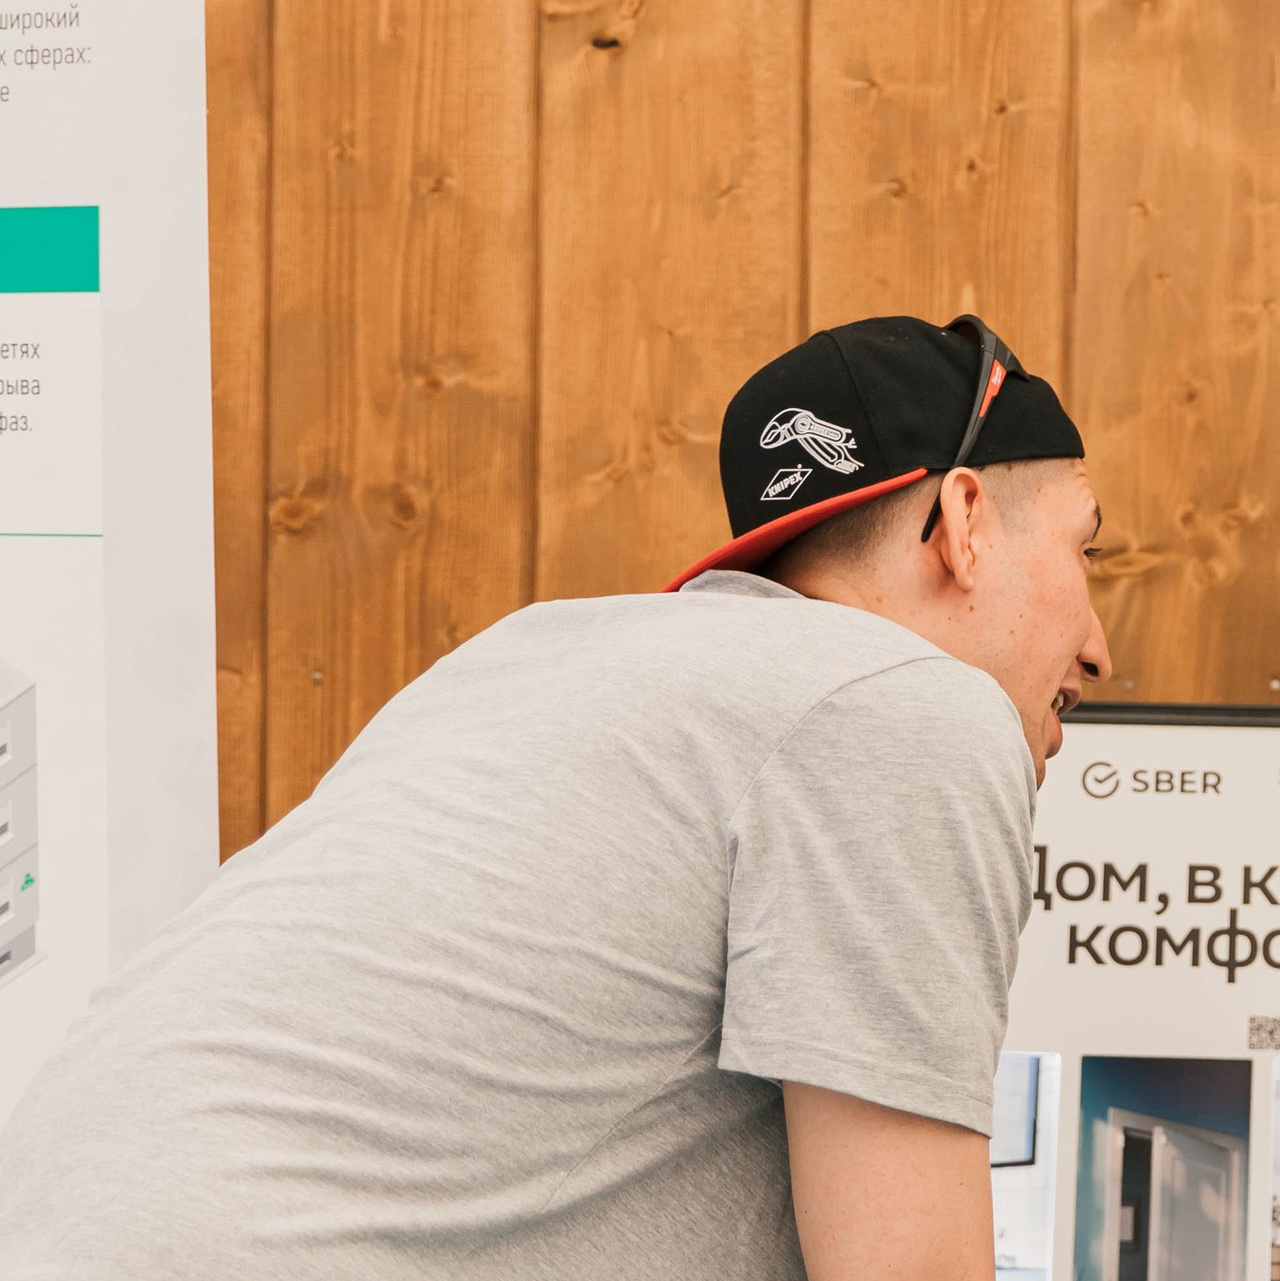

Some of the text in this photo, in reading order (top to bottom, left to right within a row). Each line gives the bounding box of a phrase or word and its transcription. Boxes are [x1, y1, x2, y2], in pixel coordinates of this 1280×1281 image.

[13, 44, 92, 71] сферах:
[0, 342, 41, 360] етях
[767, 471, 803, 498] KNIPEX
[1132, 769, 1222, 795] SBER
[1187, 864, 1223, 904] в
